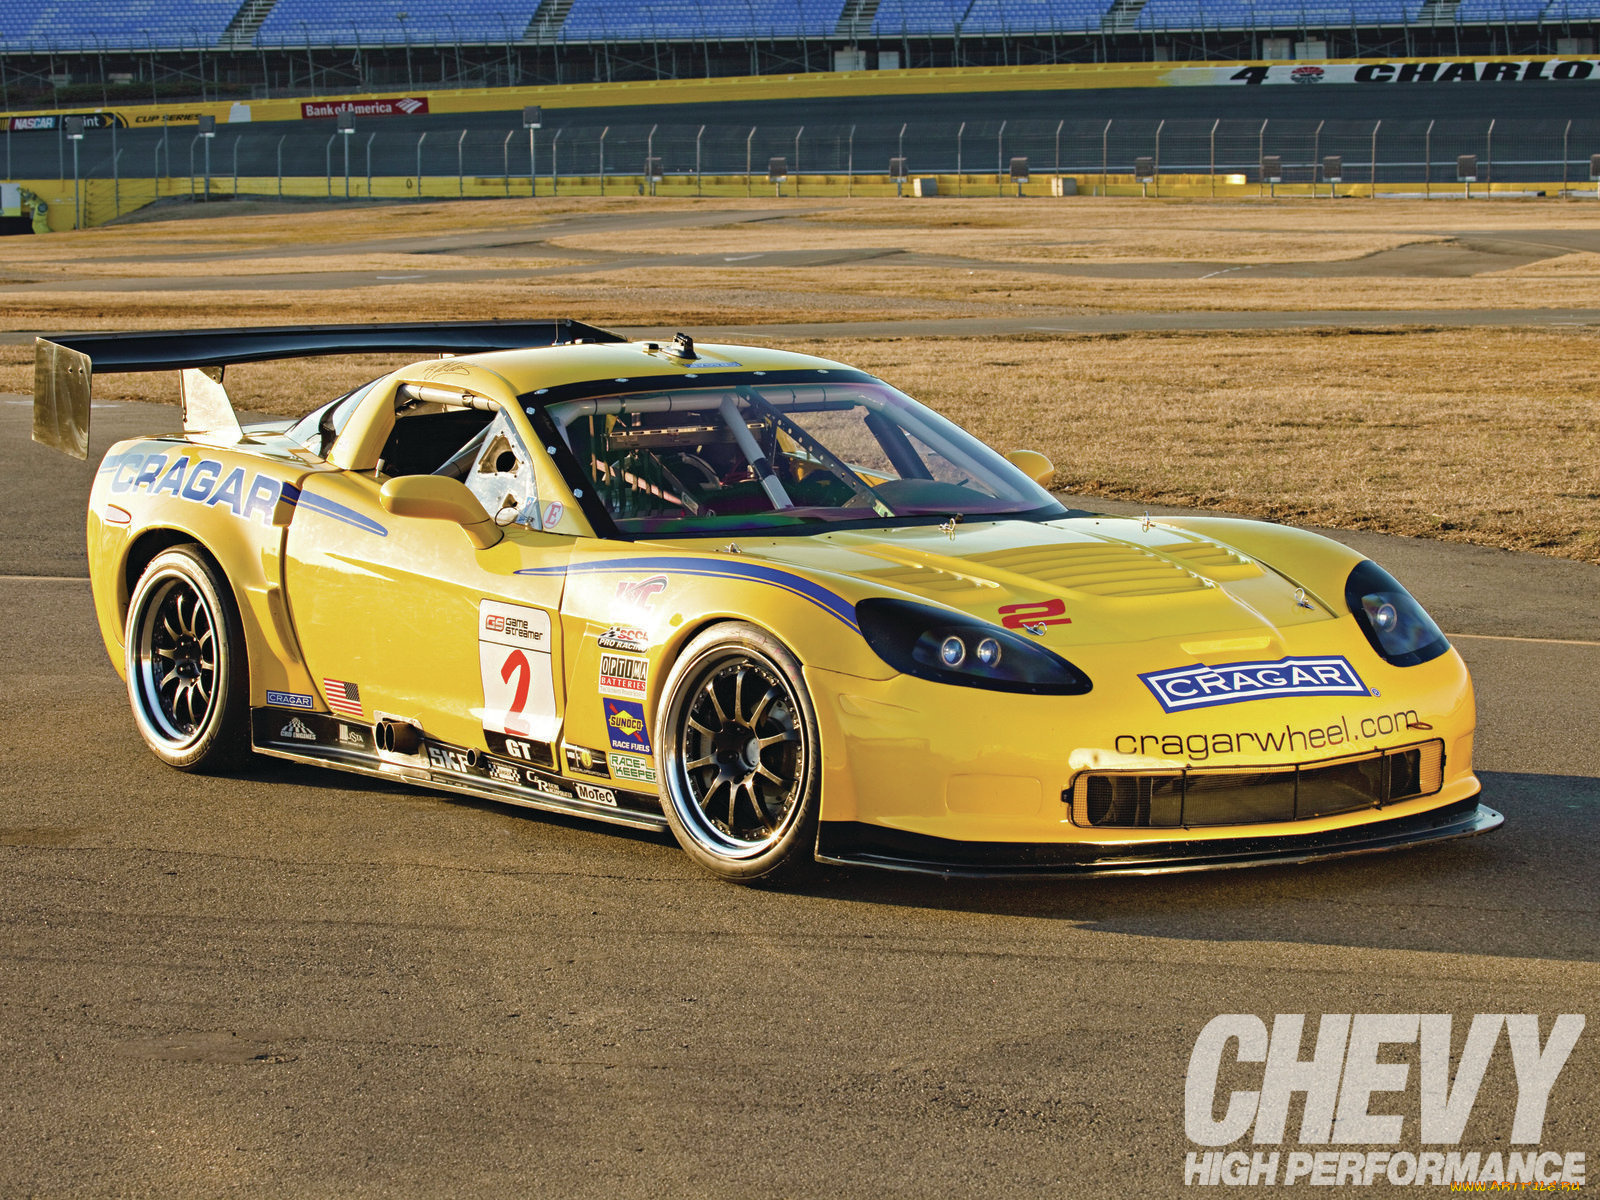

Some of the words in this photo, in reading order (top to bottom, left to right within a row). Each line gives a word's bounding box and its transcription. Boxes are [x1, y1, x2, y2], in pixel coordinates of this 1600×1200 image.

[1230, 66, 1269, 85] 4
[1354, 60, 1600, 82] CHARLO
[305, 104, 333, 116] Bank
[335, 102, 346, 114] of
[347, 102, 392, 114] America
[14, 118, 53, 129] NASCAR
[64, 115, 99, 128] Sint
[135, 115, 159, 123] CUP
[160, 113, 202, 122] SERIES
[111, 453, 283, 527] CRAGAR
[545, 504, 561, 525] E
[999, 598, 1071, 629] 2
[486, 615, 504, 632] GS
[505, 617, 528, 629] Game
[505, 626, 543, 640] Streamer
[599, 638, 616, 648] PRO
[616, 640, 645, 652] RACIN
[602, 656, 648, 681] OPTIMA
[600, 676, 646, 690] BATTERIES
[1165, 665, 1347, 697] CRAGAR
[269, 694, 310, 706] CRAGAR
[501, 649, 531, 736] 2
[610, 716, 642, 730] SUNOCO
[1114, 709, 1420, 761] cragarwheel.com
[505, 739, 532, 760] GT
[612, 740, 630, 749] RACE
[630, 743, 650, 753] FUELS
[611, 755, 645, 769] RACE-
[579, 785, 613, 802] MoTeC
